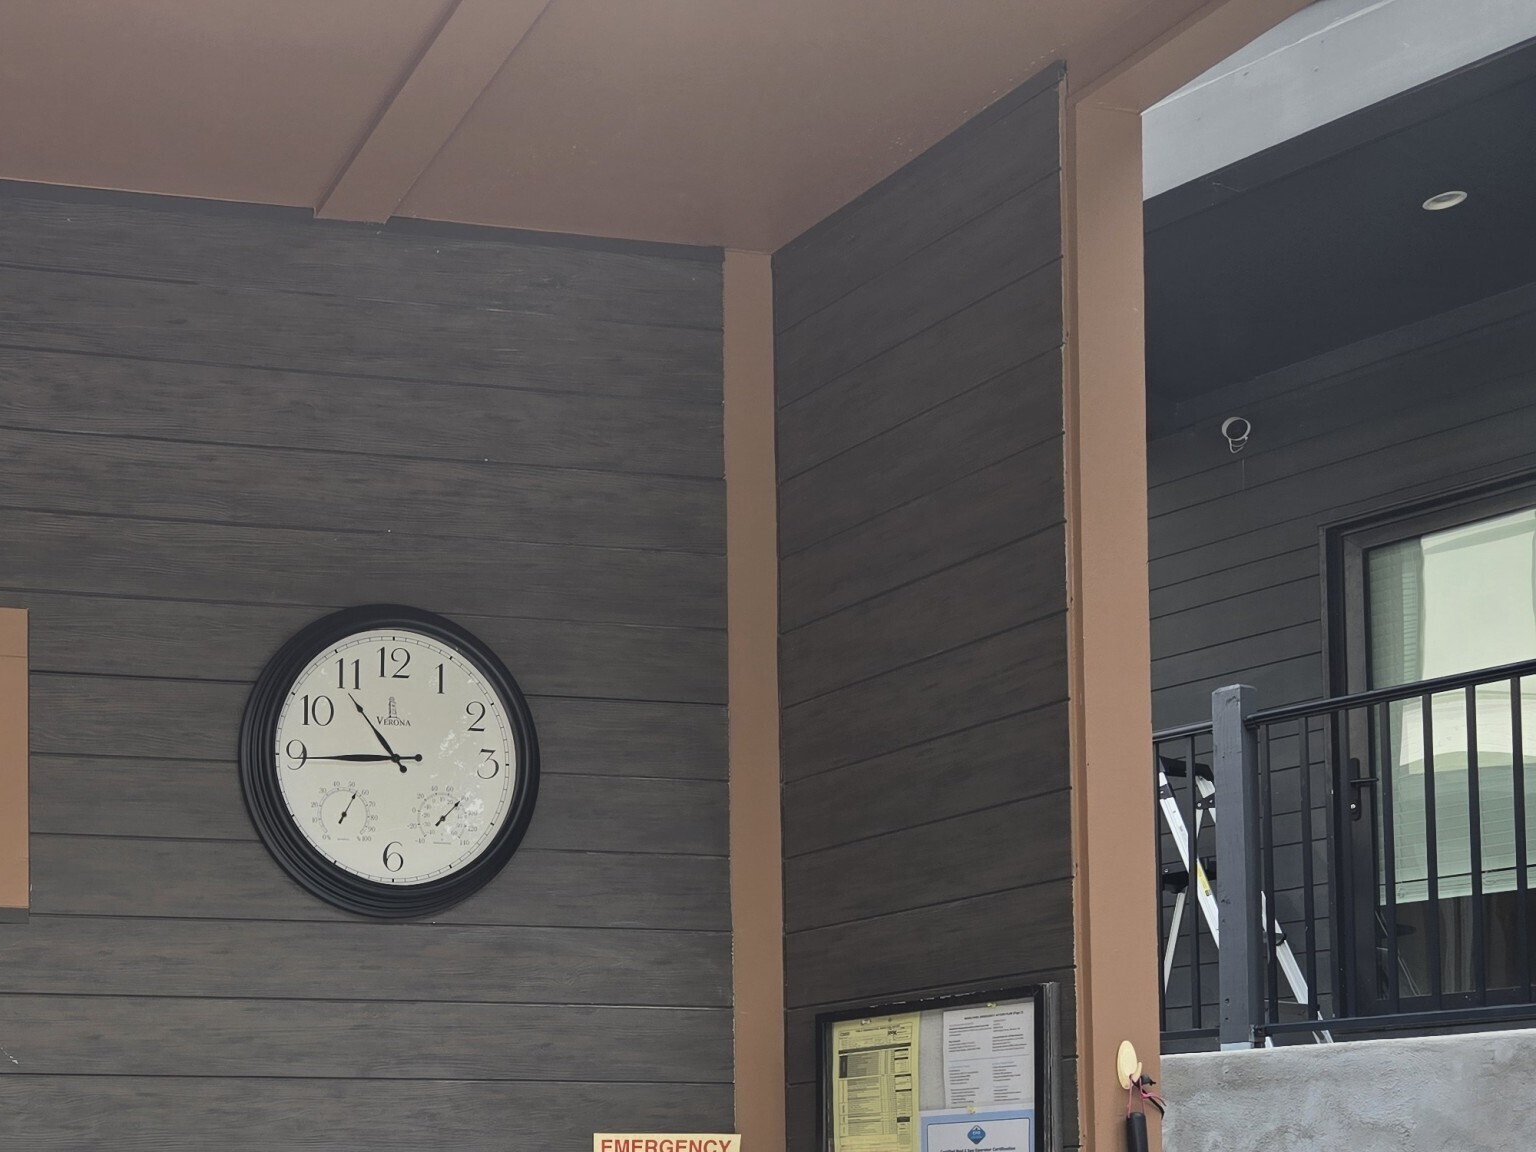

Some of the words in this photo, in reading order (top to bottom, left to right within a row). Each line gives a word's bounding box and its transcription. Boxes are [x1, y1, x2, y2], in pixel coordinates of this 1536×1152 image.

[335, 658, 361, 690] 11
[376, 646, 411, 679] 12
[434, 663, 445, 694] 1
[299, 694, 335, 726] 10
[376, 716, 411, 727] VERONA
[465, 701, 486, 732] 2
[285, 739, 308, 770] 9
[476, 748, 500, 780] 3
[382, 841, 404, 872] 6
